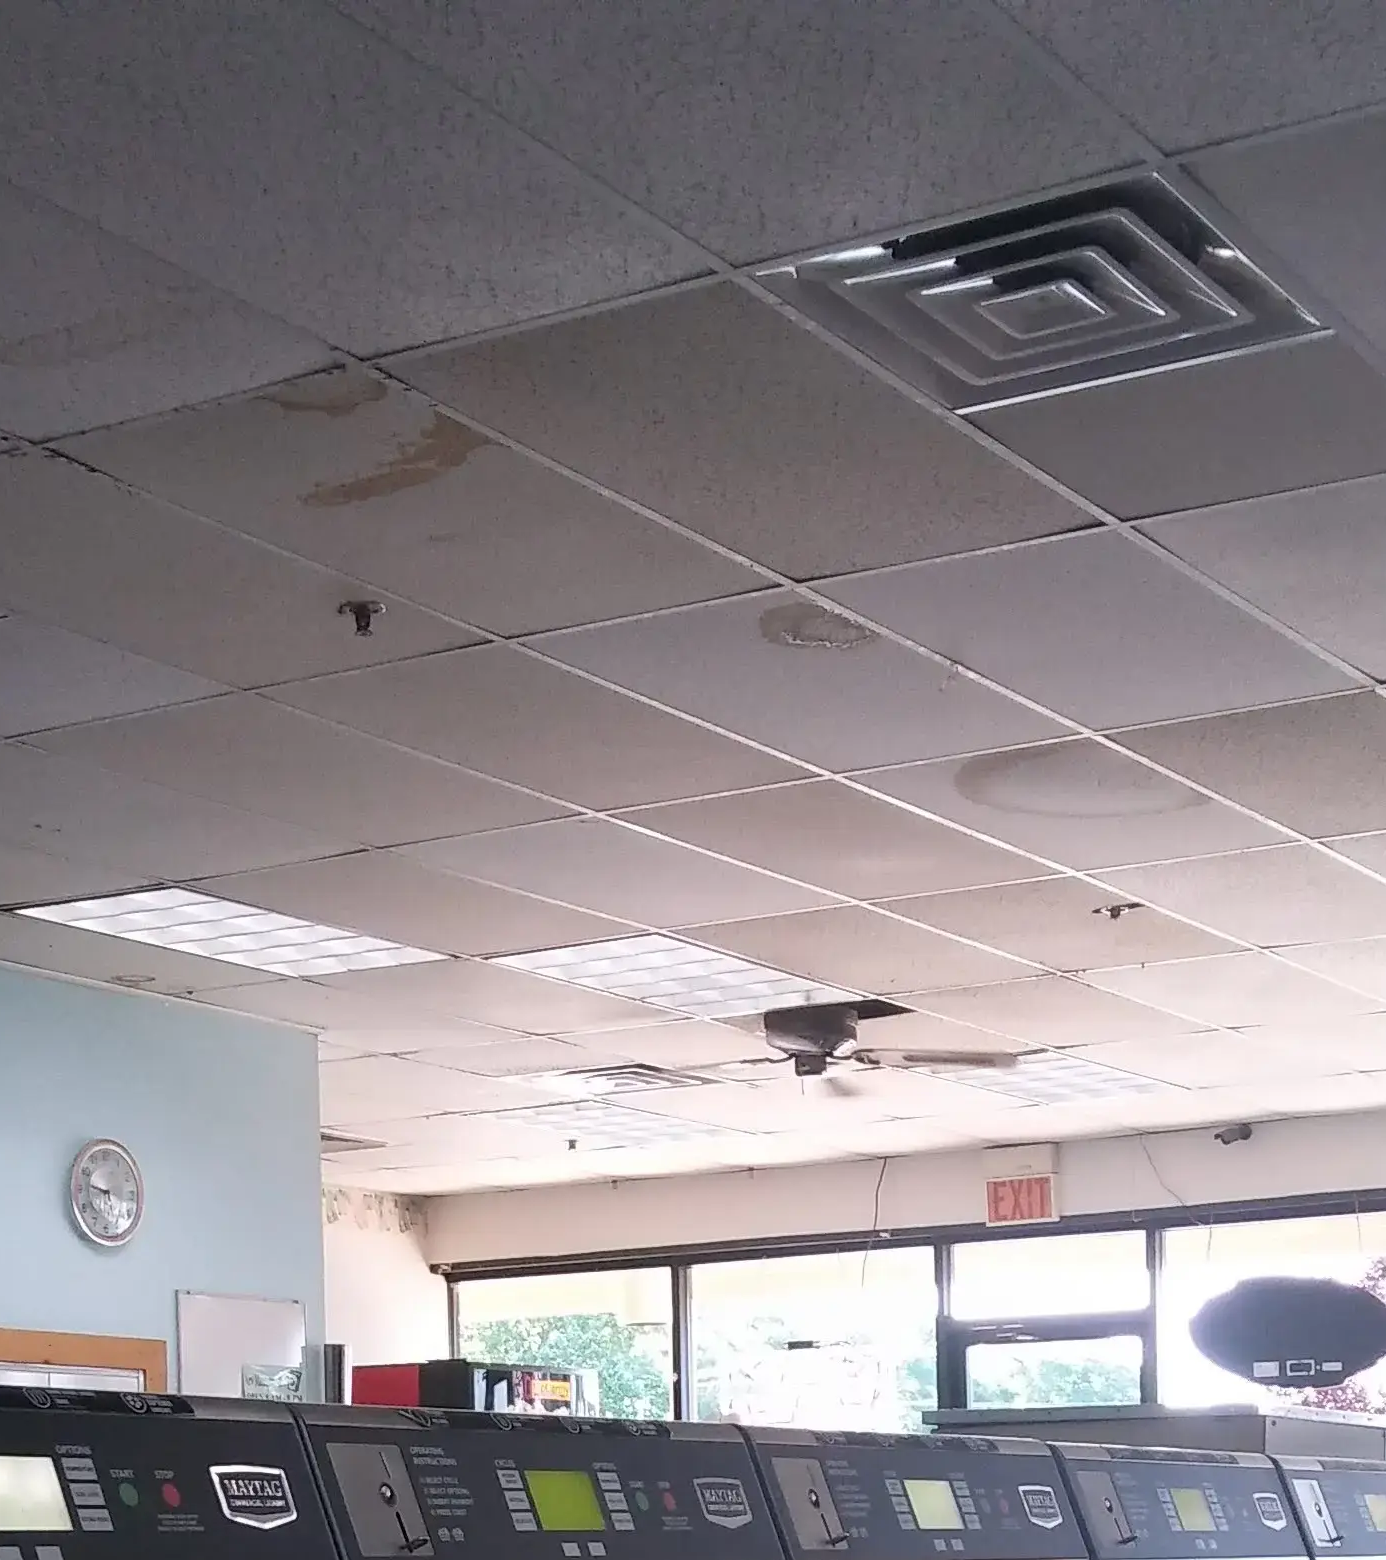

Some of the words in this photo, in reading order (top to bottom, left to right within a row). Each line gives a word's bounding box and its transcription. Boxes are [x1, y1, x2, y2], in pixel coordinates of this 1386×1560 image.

[992, 1175, 1051, 1221] EXIT
[109, 1468, 136, 1479] START
[153, 1469, 175, 1480] STOP
[223, 1479, 283, 1497] MAYTAG
